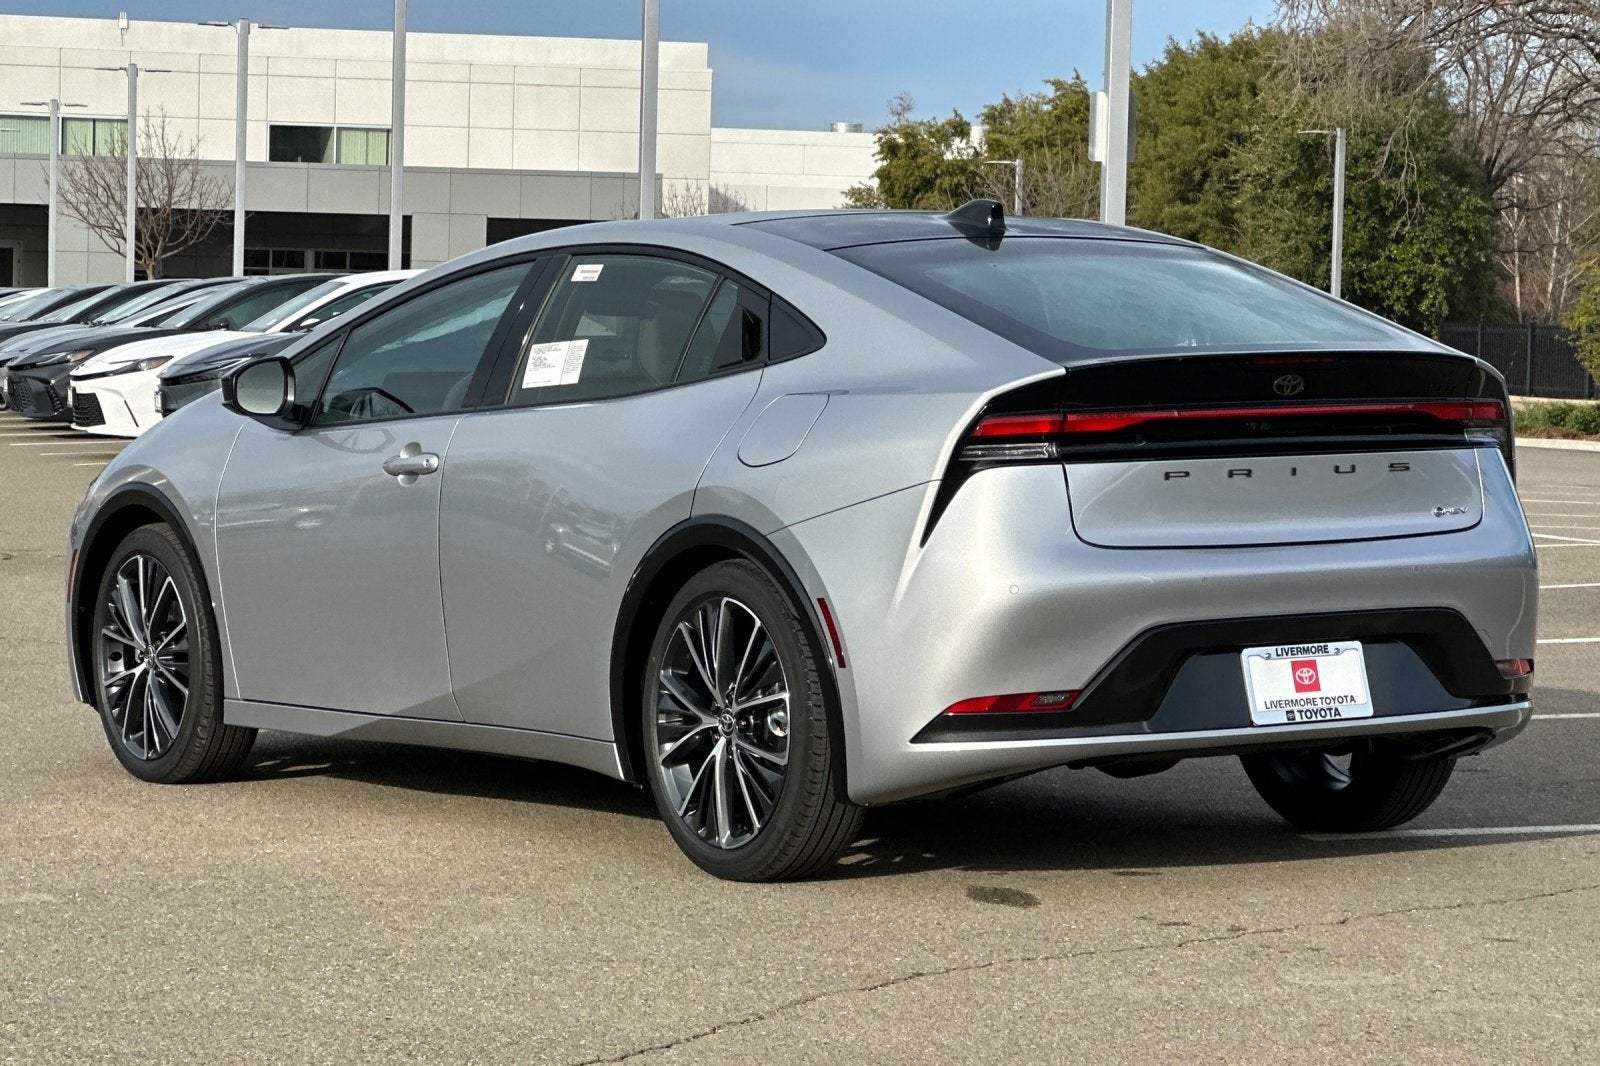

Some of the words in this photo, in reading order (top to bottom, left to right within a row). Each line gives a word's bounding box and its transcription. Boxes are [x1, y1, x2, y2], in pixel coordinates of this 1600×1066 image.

[1163, 462, 1410, 481] PRIUS
[1275, 644, 1330, 657] LIVERMORE
[1264, 697, 1318, 710] LIVERMORE
[1320, 694, 1357, 706] TOYOTA
[1297, 707, 1342, 720] TOYOTA
